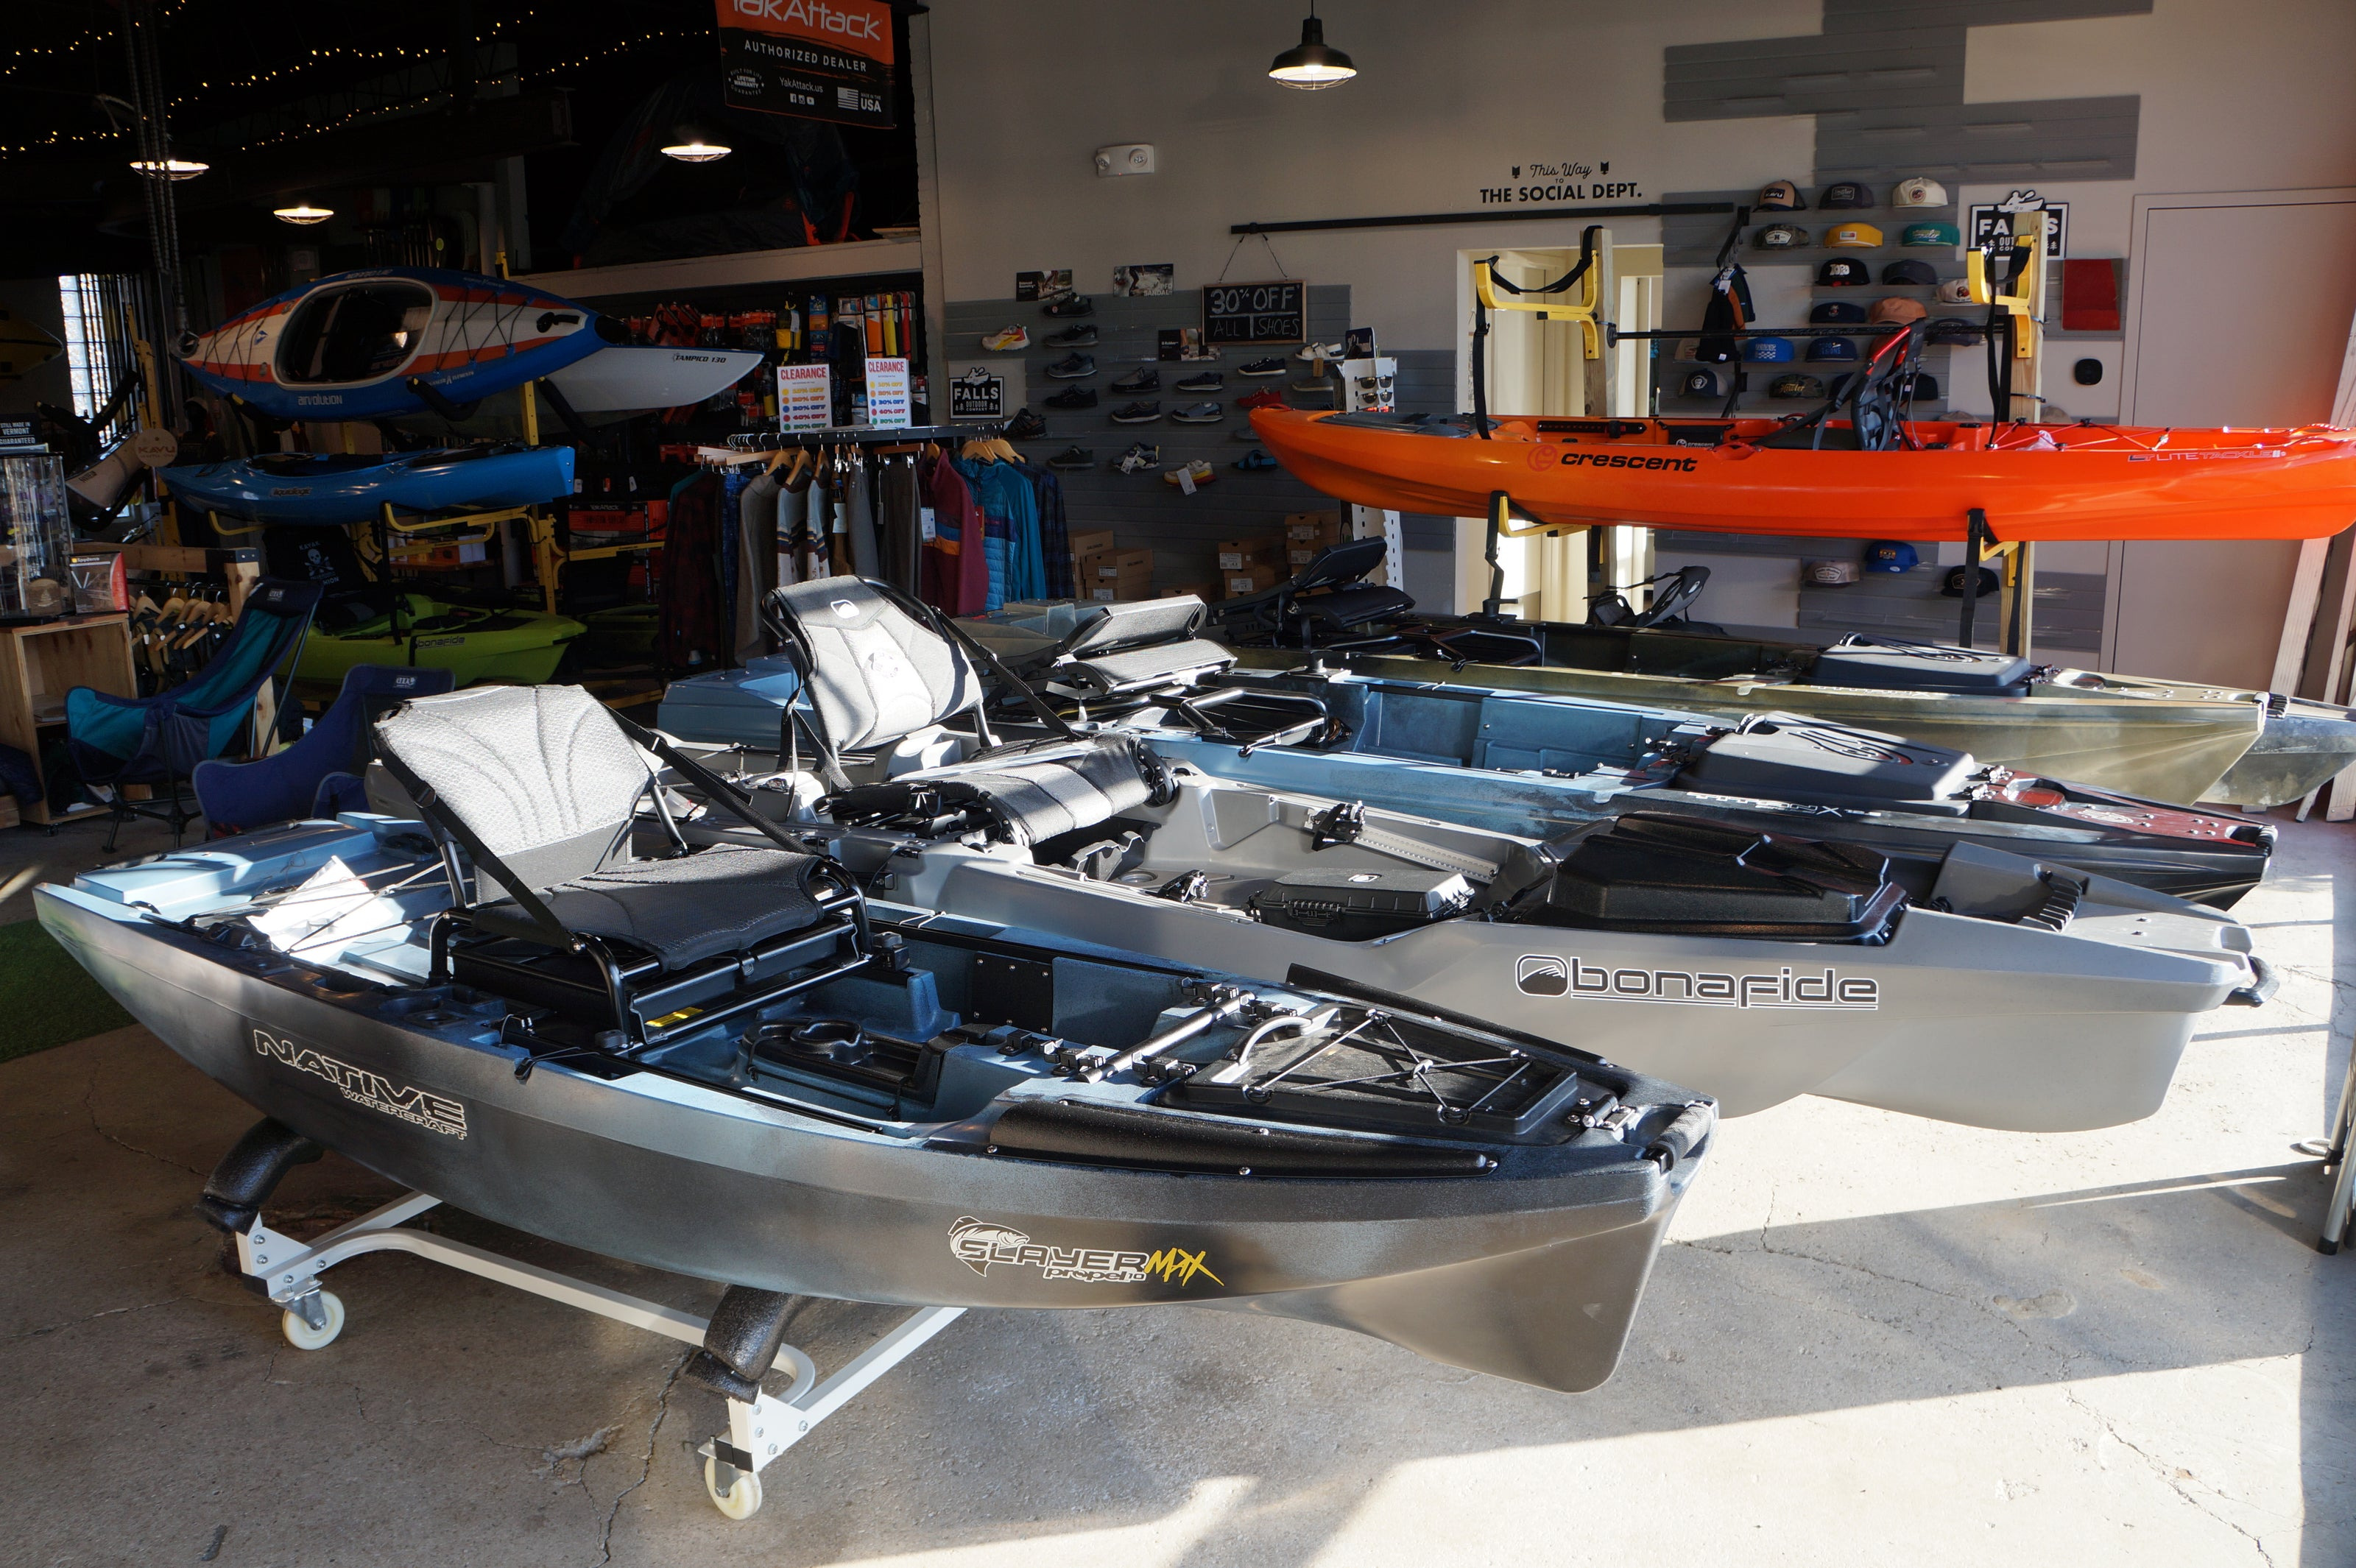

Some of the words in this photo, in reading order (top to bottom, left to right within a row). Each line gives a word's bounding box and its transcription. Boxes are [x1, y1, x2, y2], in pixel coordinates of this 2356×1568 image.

[744, 40, 818, 63] AUTHORIZED
[823, 55, 867, 72] DEALER
[734, 80, 759, 88] WARRANTY
[779, 77, 823, 93] YakAttack.us
[861, 98, 882, 113] USA
[1530, 164, 1559, 178] This
[1561, 162, 1593, 179] Way
[1480, 188, 1512, 204] THE
[1518, 184, 1585, 202] SOCIAL
[1592, 182, 1643, 199] DEPT.
[1979, 218, 2059, 236] FAS
[1210, 288, 1250, 314] 30%
[1214, 317, 1241, 336] ALL
[1257, 317, 1300, 336] SHOES
[780, 367, 827, 380] CLEARANCE
[868, 361, 904, 372] CLEARANCE
[954, 387, 998, 400] FALLS
[2, 427, 29, 435] VERMONT
[138, 445, 176, 453] KAVU
[1560, 453, 1698, 472] crescent
[417, 636, 465, 649] bonafide
[1570, 956, 1879, 1010] bonafide
[253, 1029, 468, 1130] NATIVE
[339, 1087, 468, 1140] WATERCRAFT
[955, 1237, 1150, 1274] SLAYER
[1143, 1247, 1225, 1287] MAX
[1042, 1265, 1129, 1283] propel
